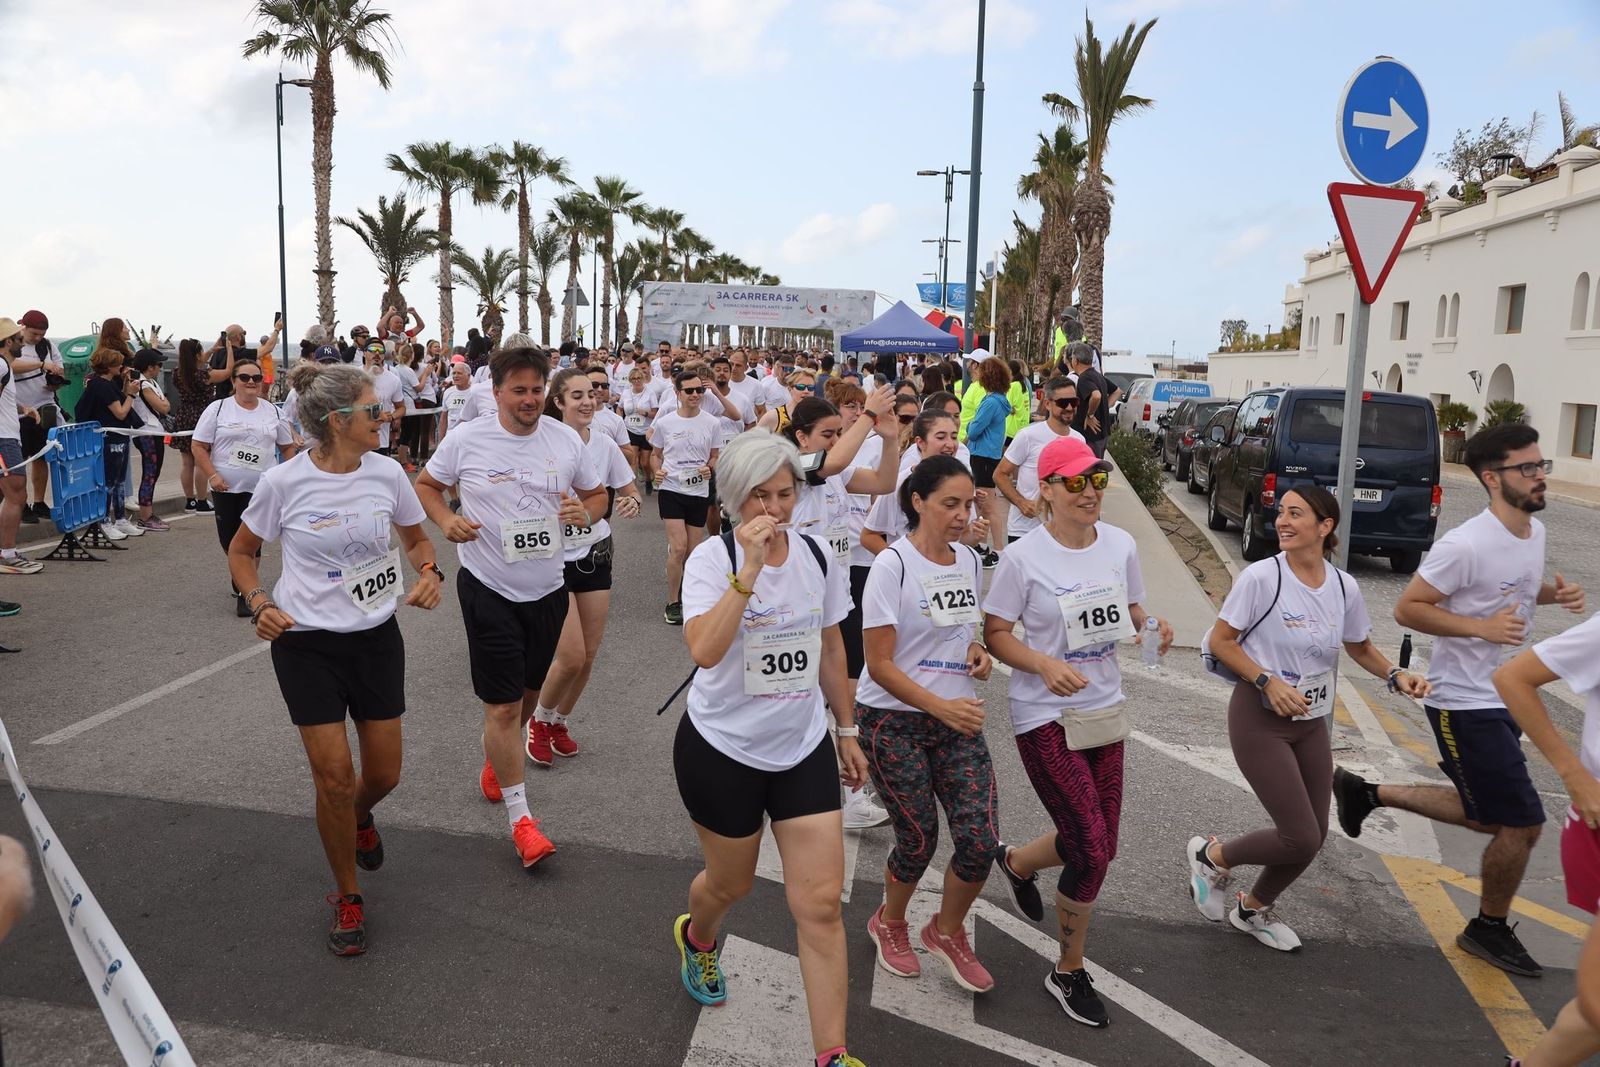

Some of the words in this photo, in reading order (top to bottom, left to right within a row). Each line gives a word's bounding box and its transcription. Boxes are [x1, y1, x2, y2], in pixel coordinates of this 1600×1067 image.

[716, 291, 730, 300] 3A
[732, 292, 783, 302] CARRERA
[786, 293, 799, 303] 5K
[863, 339, 937, 348] info@dorsalchip.es
[237, 450, 259, 464] 962
[685, 474, 703, 486] 103
[1360, 490, 1378, 500] HNR
[513, 530, 551, 549] 856
[351, 565, 397, 602] 1205
[931, 588, 976, 611] 1225
[1078, 603, 1121, 630] 186
[771, 631, 797, 639] CARRERA
[761, 650, 809, 675] 309
